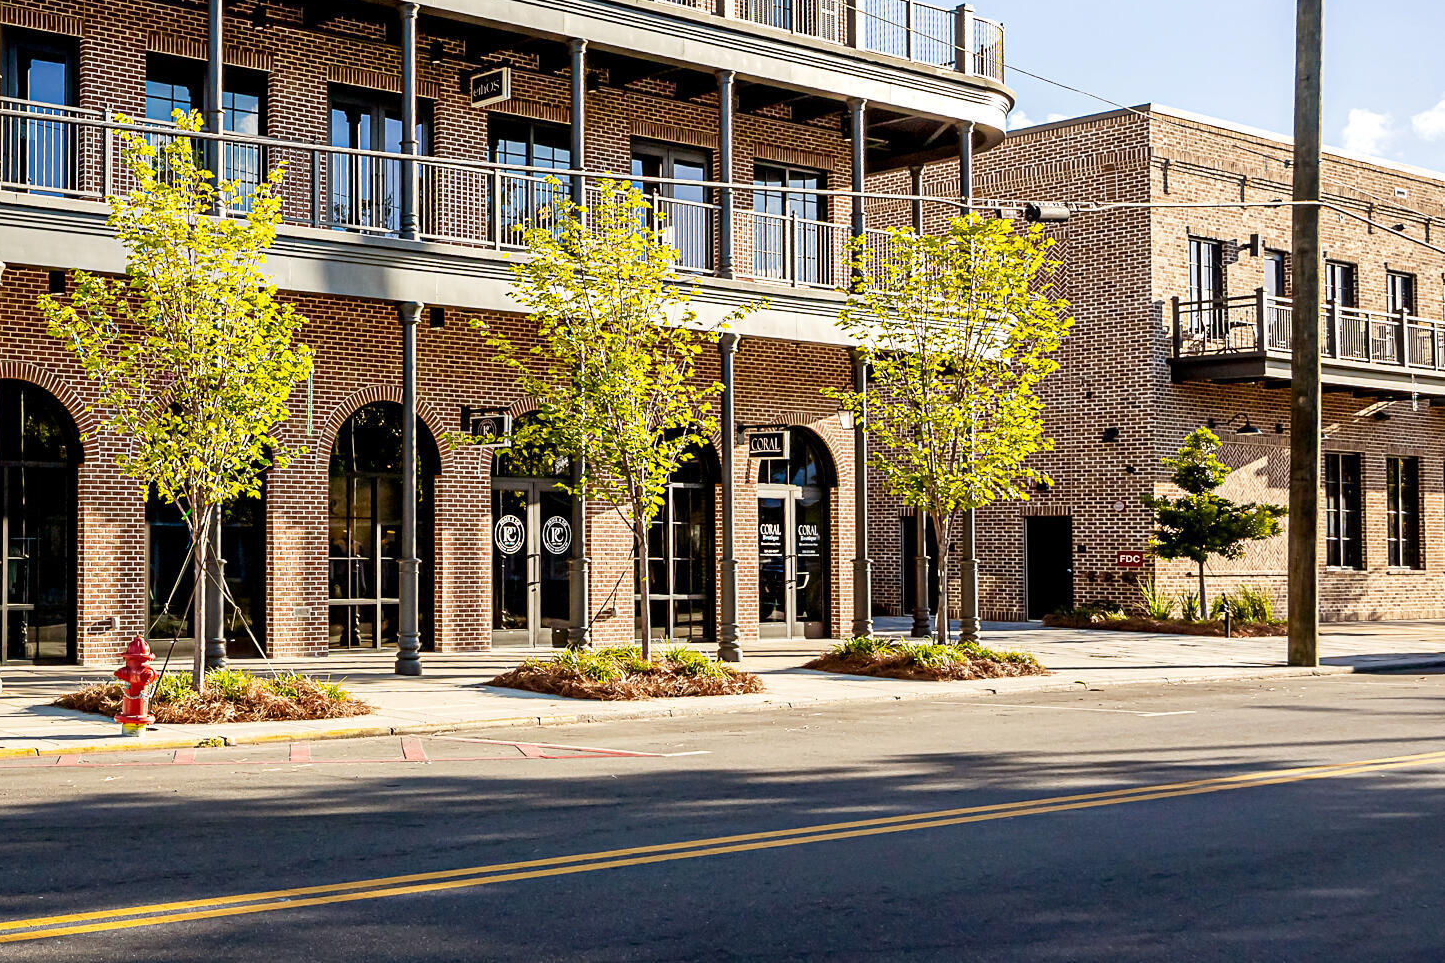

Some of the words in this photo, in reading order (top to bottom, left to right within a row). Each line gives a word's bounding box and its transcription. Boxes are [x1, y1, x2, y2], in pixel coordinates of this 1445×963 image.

[751, 437, 781, 451] CORAL
[760, 524, 781, 535] CORAL
[798, 524, 819, 536] CORAL
[1119, 554, 1141, 563] FDC
